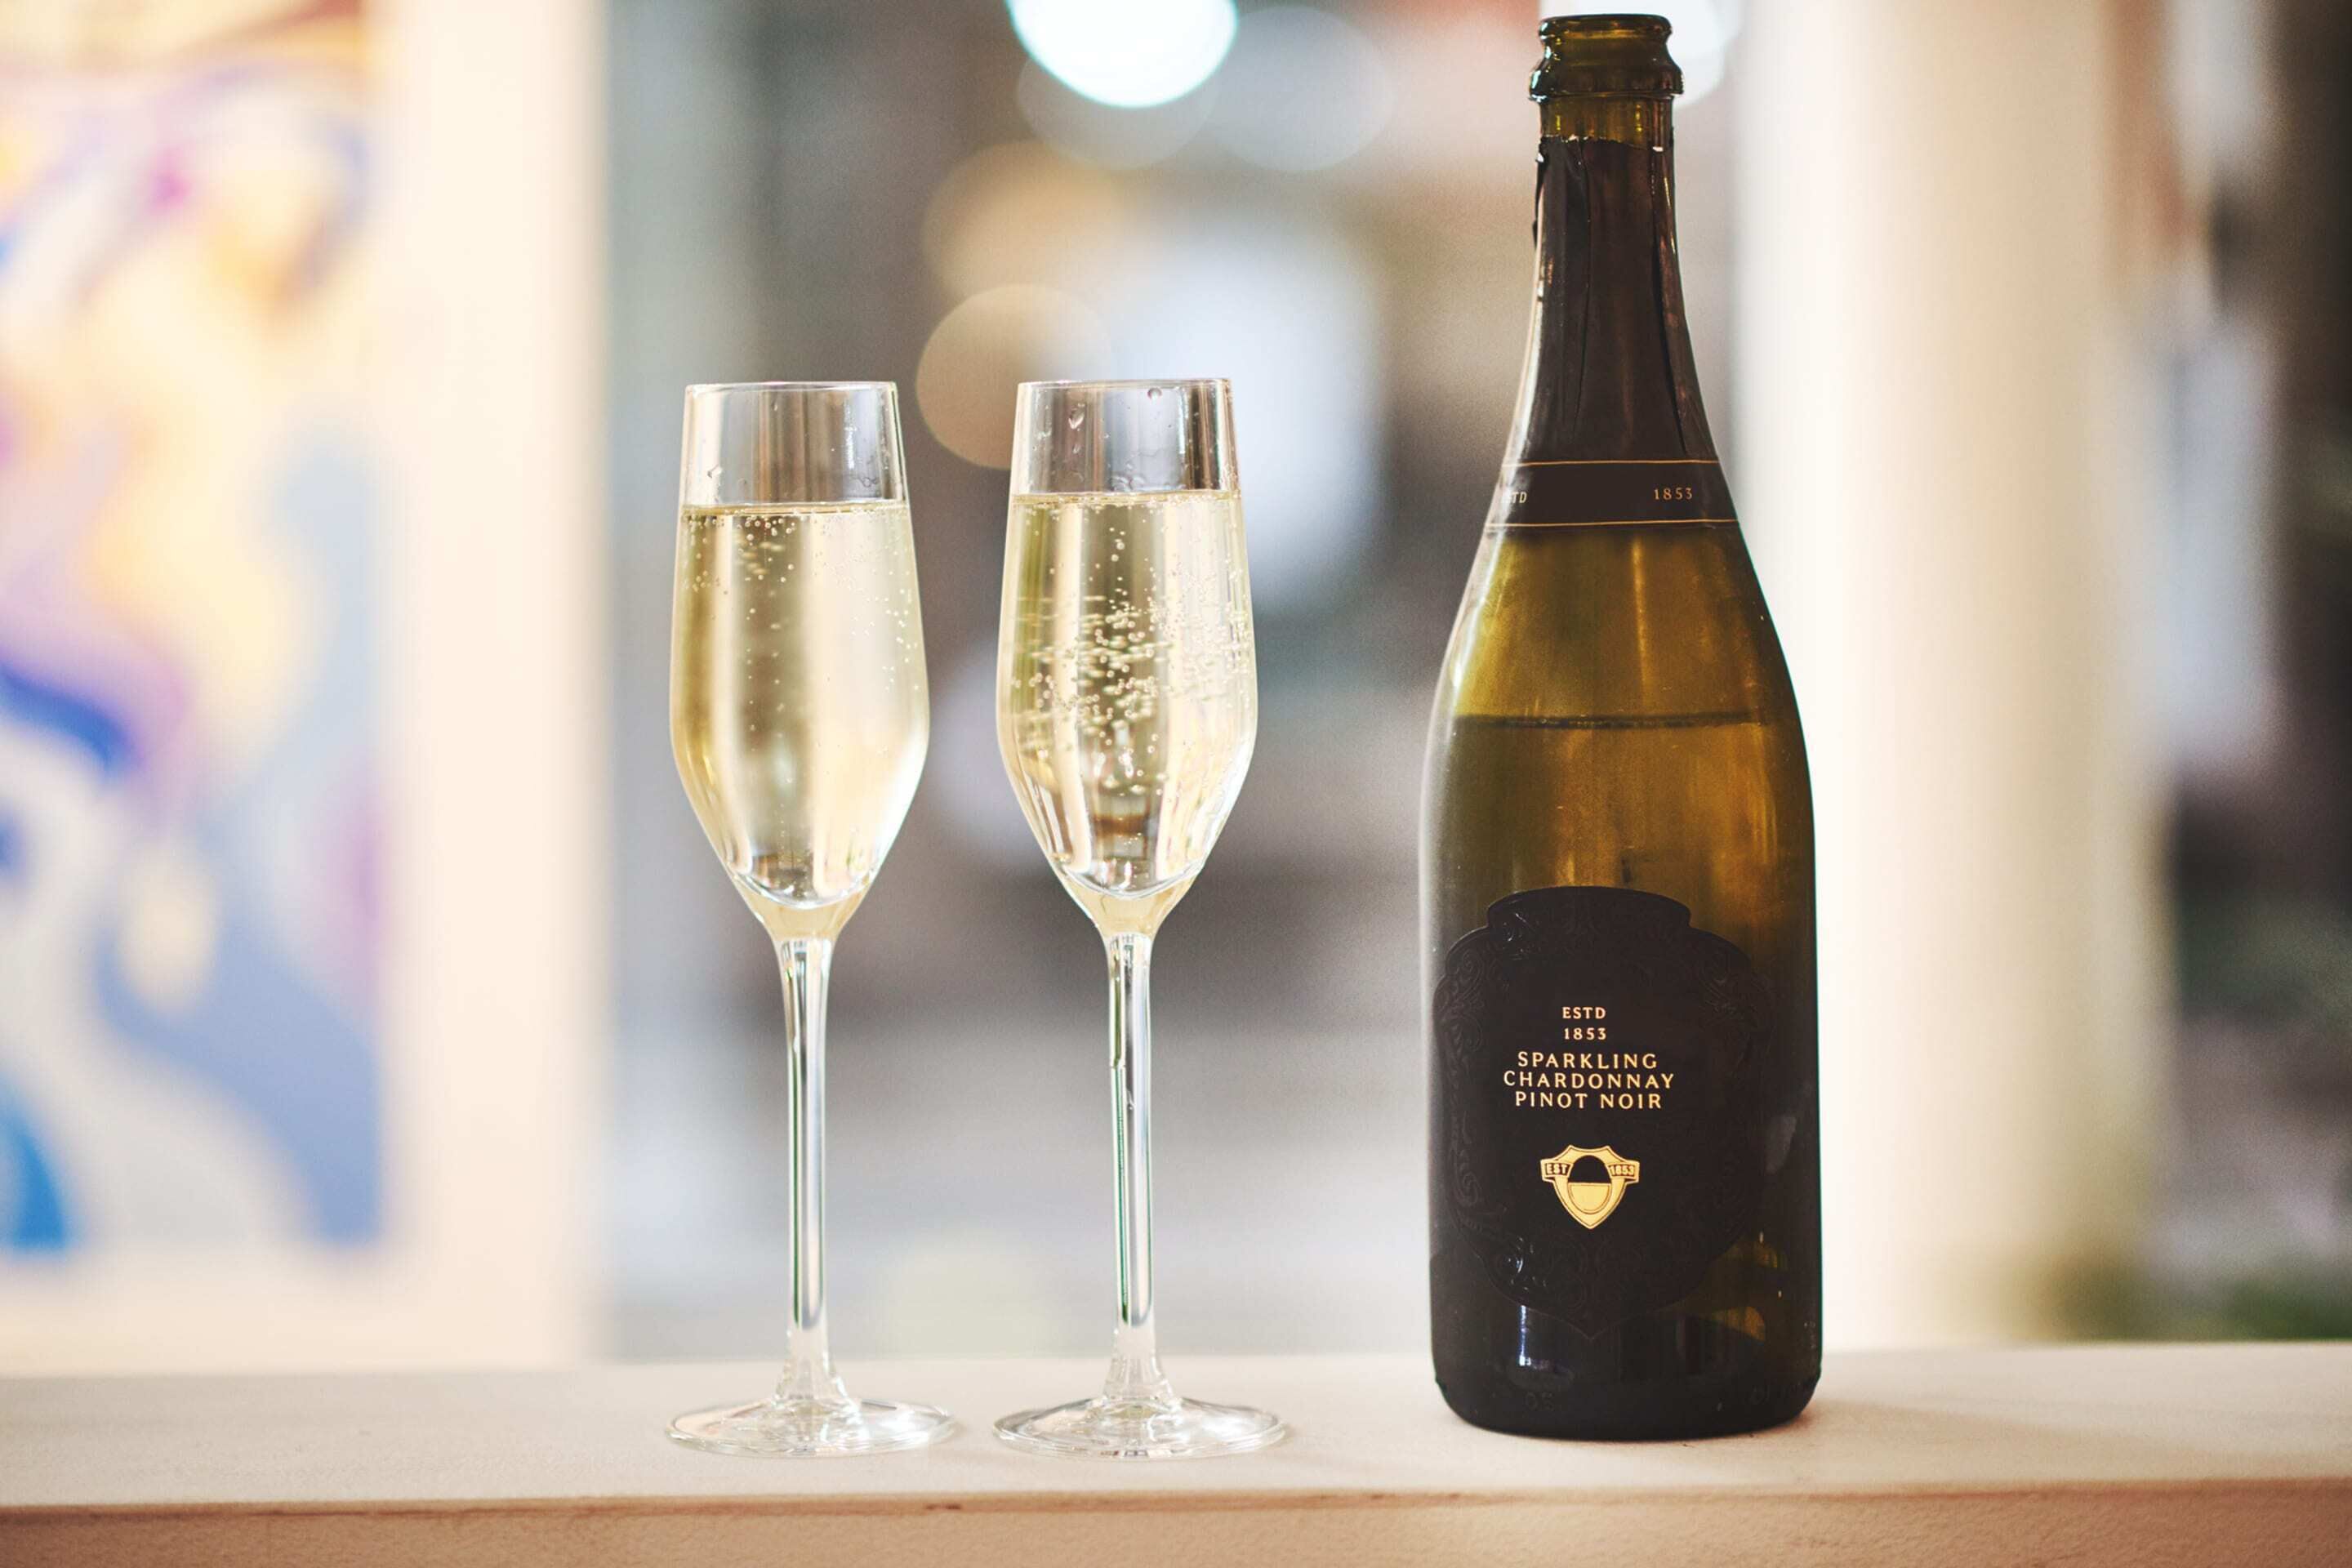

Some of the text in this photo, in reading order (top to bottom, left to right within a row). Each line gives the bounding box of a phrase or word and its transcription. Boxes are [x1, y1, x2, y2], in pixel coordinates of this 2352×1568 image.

[1654, 487, 1693, 501] 1853
[1561, 1006, 1606, 1020] ESTD
[1564, 1027, 1607, 1040] 1853
[1517, 1050, 1657, 1070] SPARKLING
[1503, 1070, 1674, 1089] CHARDONNAY
[1515, 1091, 1662, 1110] PINOT NOIR
[1546, 1164, 1635, 1177] EST 1853
